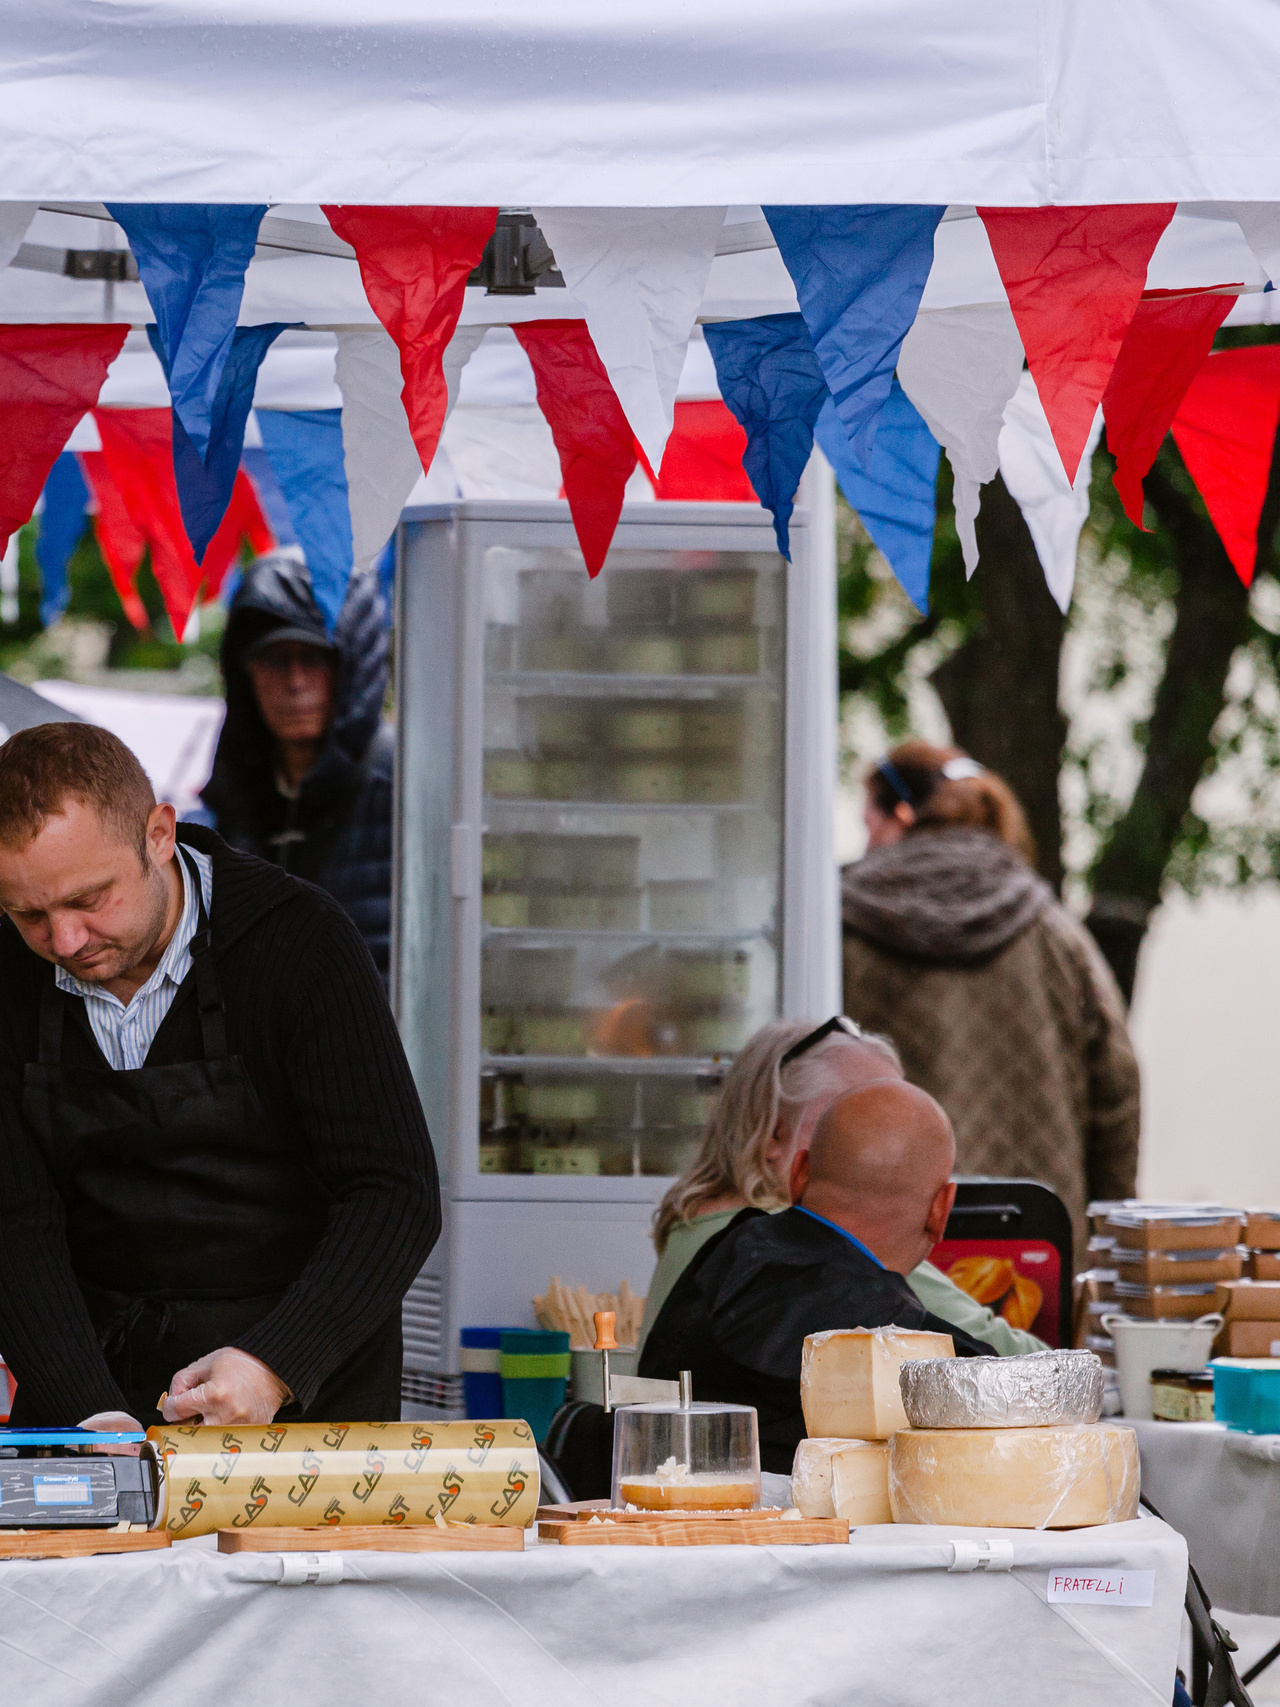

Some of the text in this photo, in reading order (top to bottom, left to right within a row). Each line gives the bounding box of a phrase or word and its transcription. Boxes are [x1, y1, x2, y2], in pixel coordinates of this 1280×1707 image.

[211, 1433, 243, 1485] CAST
[322, 1422, 351, 1450] CAS
[403, 1427, 434, 1474] CAST
[466, 1424, 496, 1468] CAST
[287, 1448, 324, 1508] CAST
[352, 1445, 388, 1503] CAST
[425, 1464, 465, 1518] CAST
[490, 1461, 529, 1519] CAST
[167, 1480, 208, 1533] CAST
[231, 1476, 273, 1528] CAST
[317, 1500, 346, 1526] ST
[382, 1496, 411, 1526] AST
